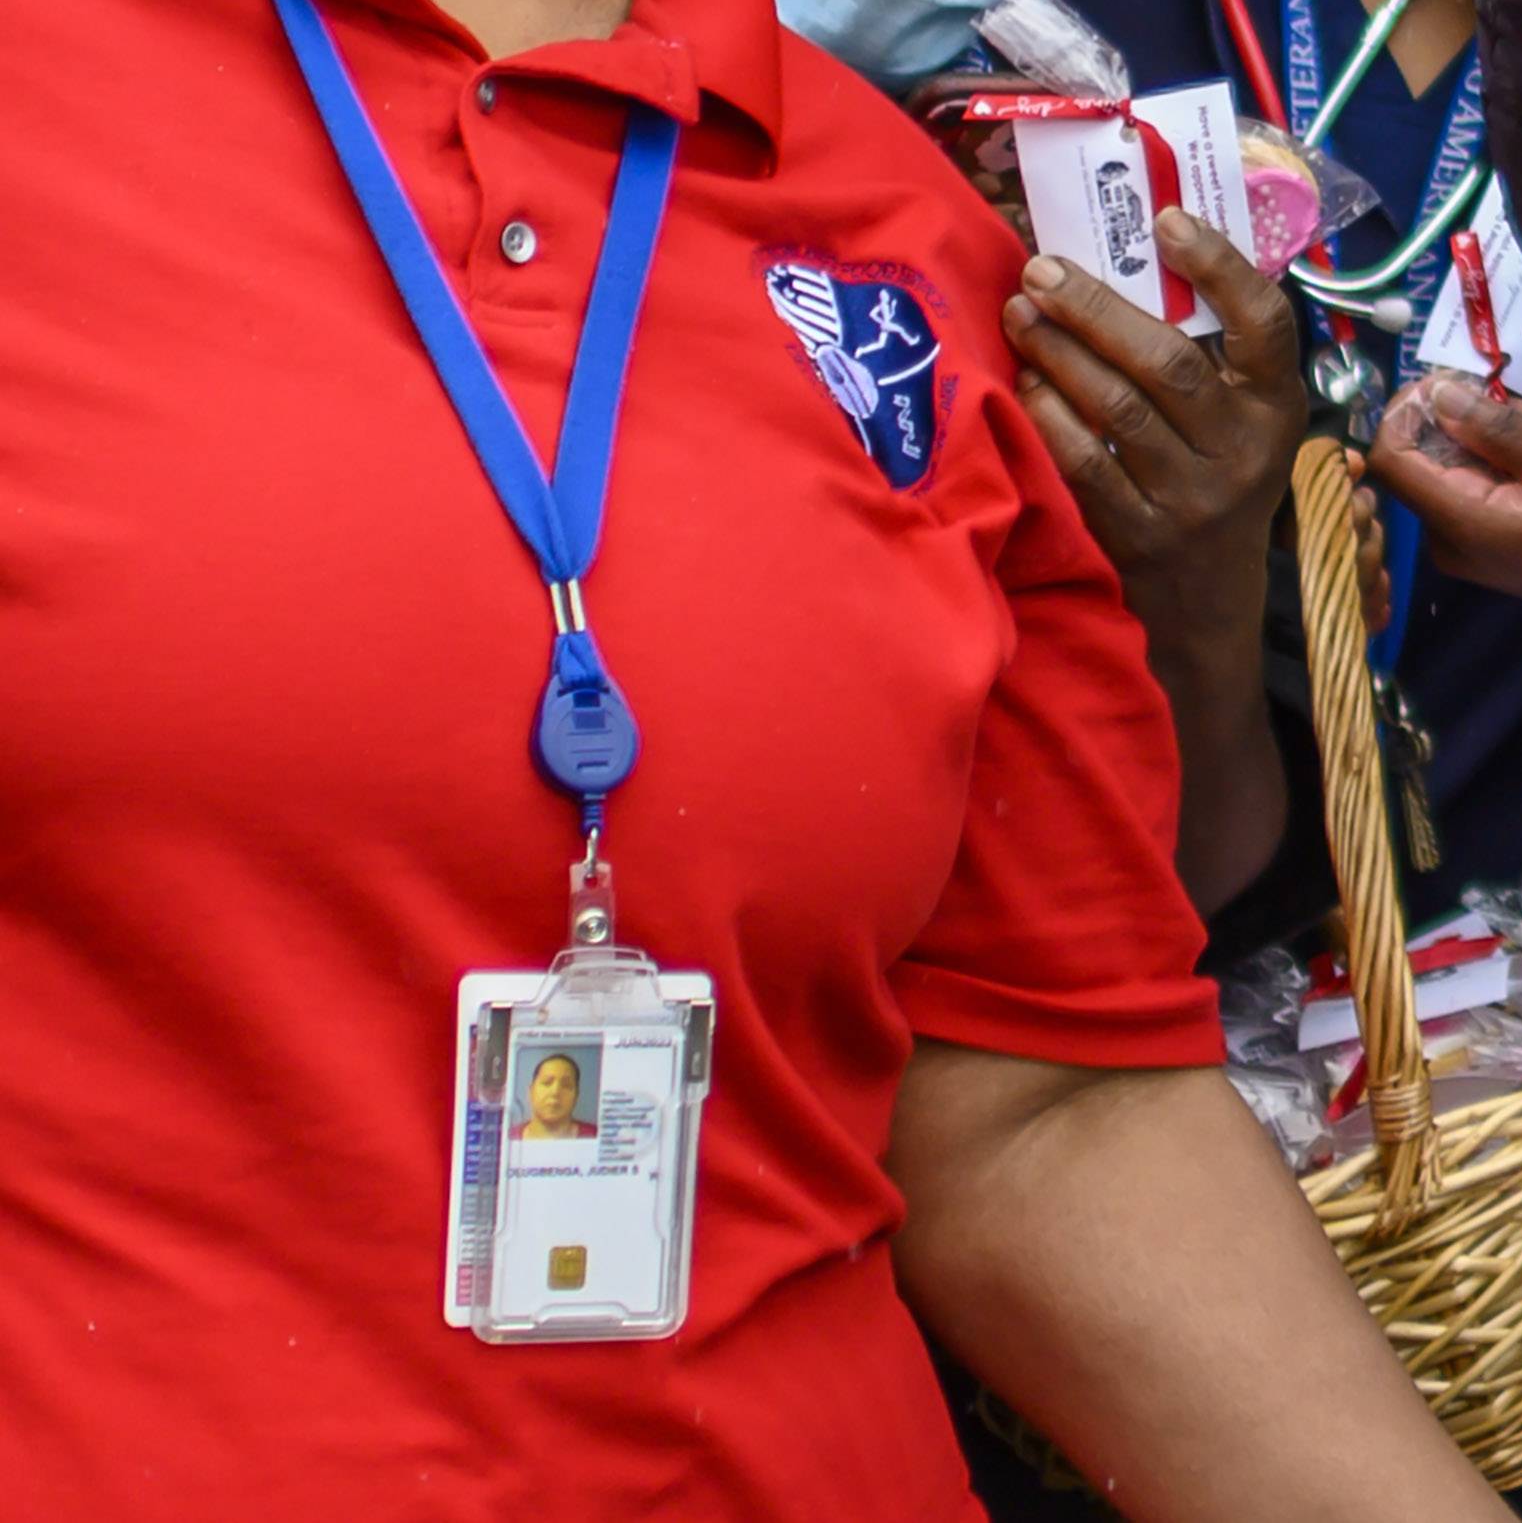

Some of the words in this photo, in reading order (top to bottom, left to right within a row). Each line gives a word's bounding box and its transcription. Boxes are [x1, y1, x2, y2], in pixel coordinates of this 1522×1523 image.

[1188, 140, 1198, 161] We
[1198, 105, 1210, 138] Have
[1206, 154, 1222, 190] sweet
[1407, 97, 1485, 301] AMERIAN
